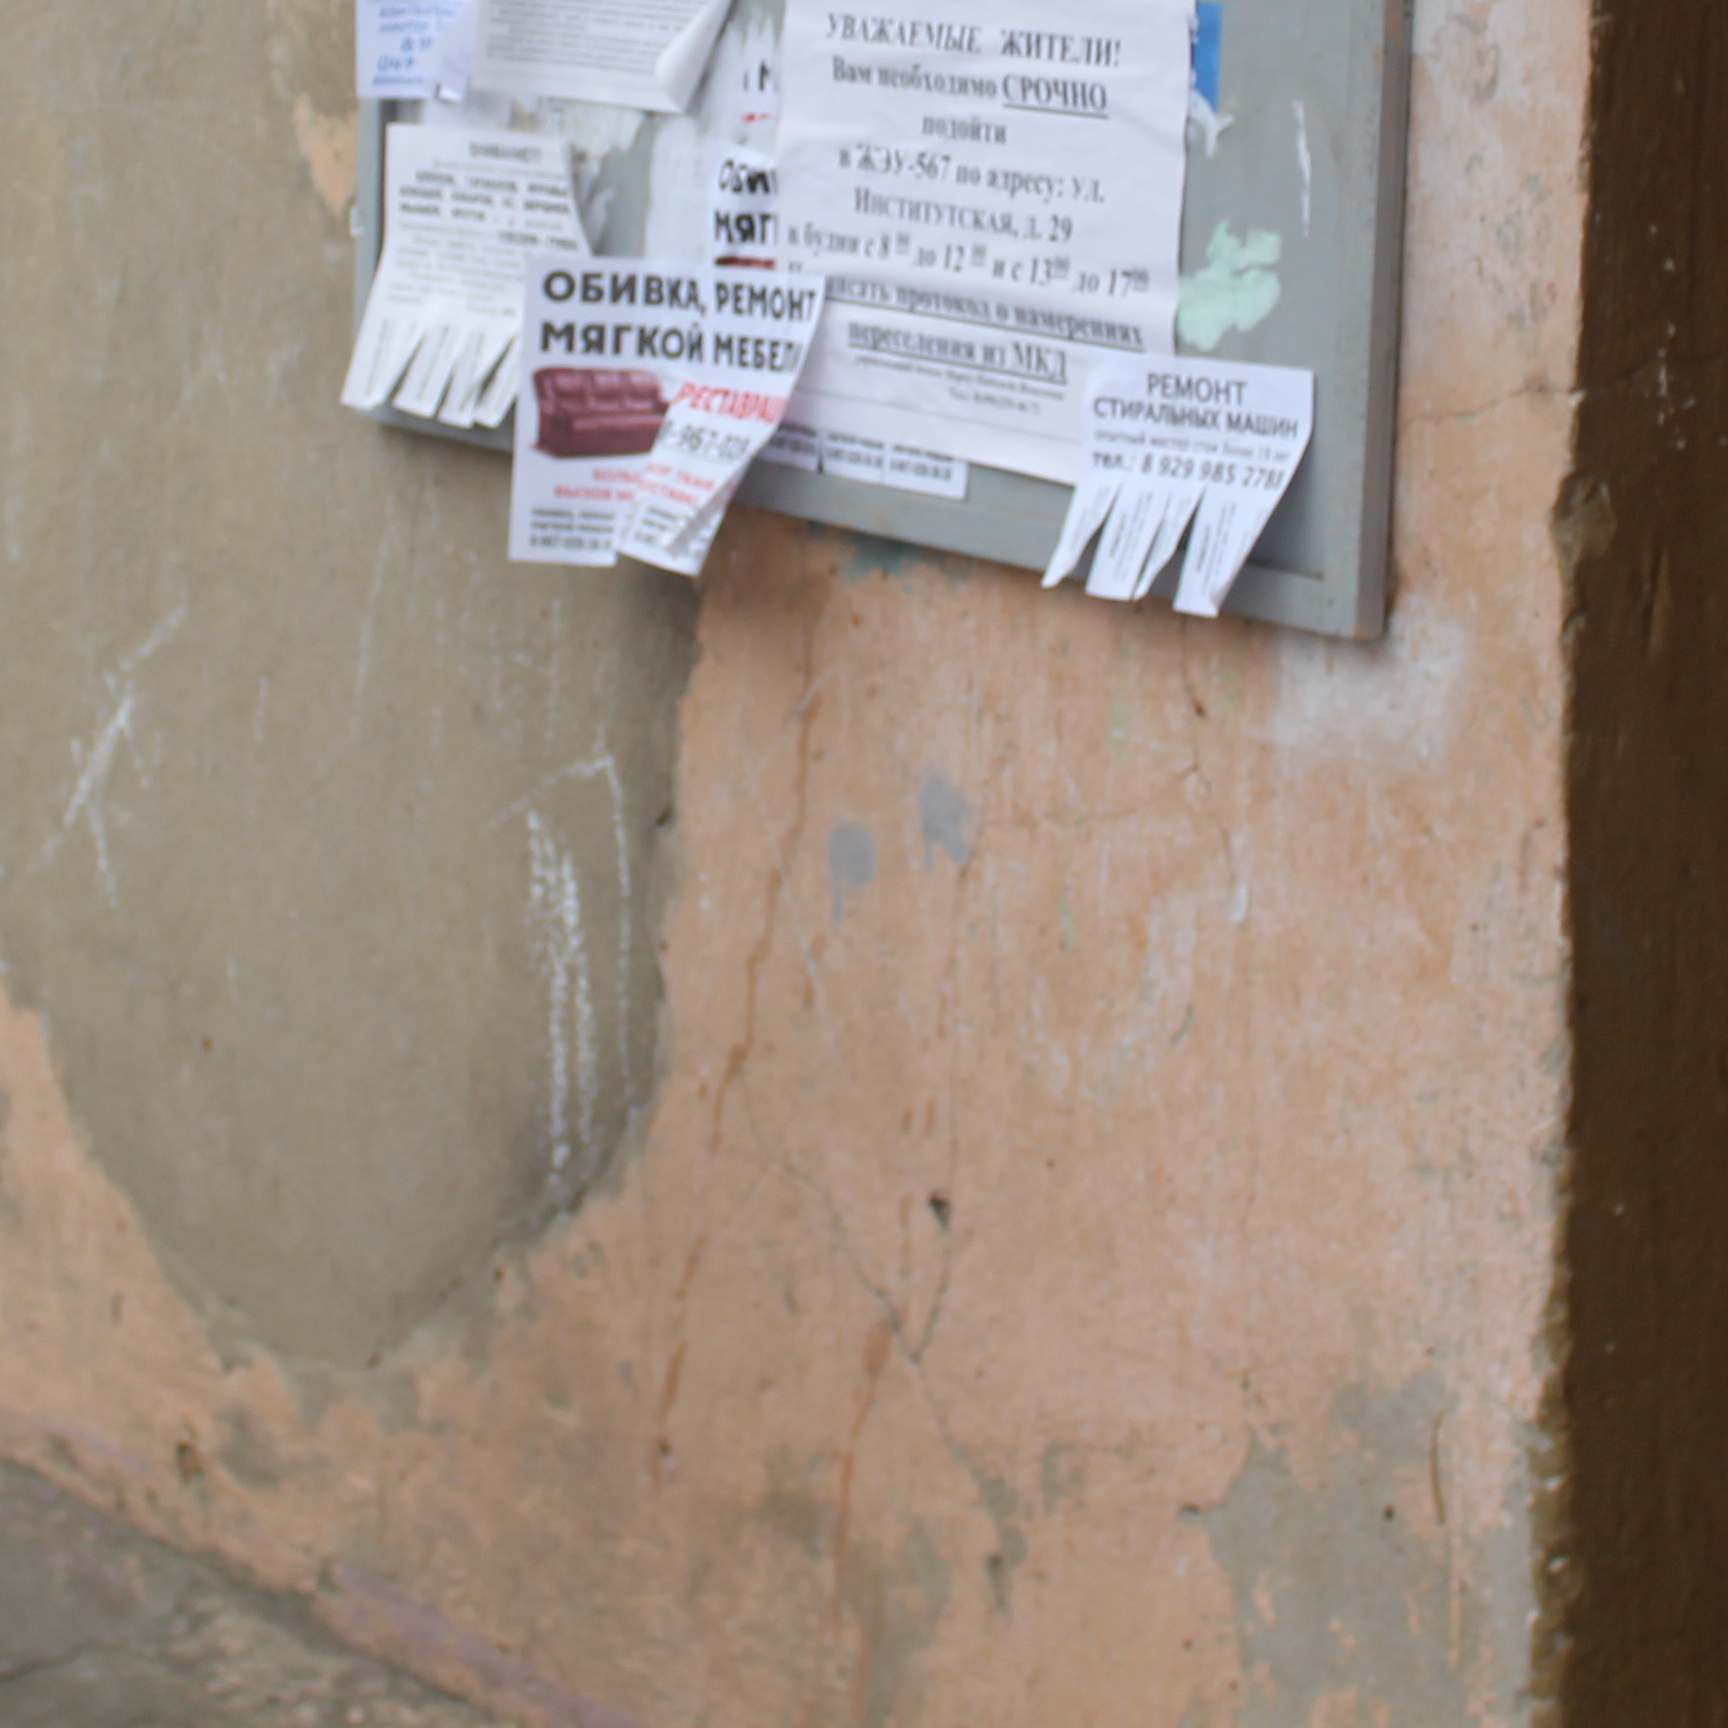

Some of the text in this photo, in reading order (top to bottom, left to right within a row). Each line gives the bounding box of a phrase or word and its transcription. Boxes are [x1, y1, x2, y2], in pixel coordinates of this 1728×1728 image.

[827, 12, 1121, 68] УВАЖАЕМЫЕ ЖИТЕЛИ!
[832, 55, 1109, 114] Вам необходимо СРОЧНО
[921, 113, 1007, 145] подойти
[839, 148, 851, 169] в
[854, 143, 952, 182] ЖЭУ-567
[956, 164, 981, 186] по
[986, 170, 1065, 205] адресу:
[803, 221, 859, 256] будни
[943, 243, 965, 273] 12
[1048, 213, 1072, 244] 29
[542, 270, 817, 321] ОБИВКА, РЕМОНТ
[540, 320, 704, 364] МЯГКОЙ
[1147, 371, 1248, 407] РЕМОНТ
[1092, 396, 1300, 441] СТИРАЛЬНЫХ МАШИН
[1140, 453, 1153, 474] 8
[1159, 456, 1195, 479] 929
